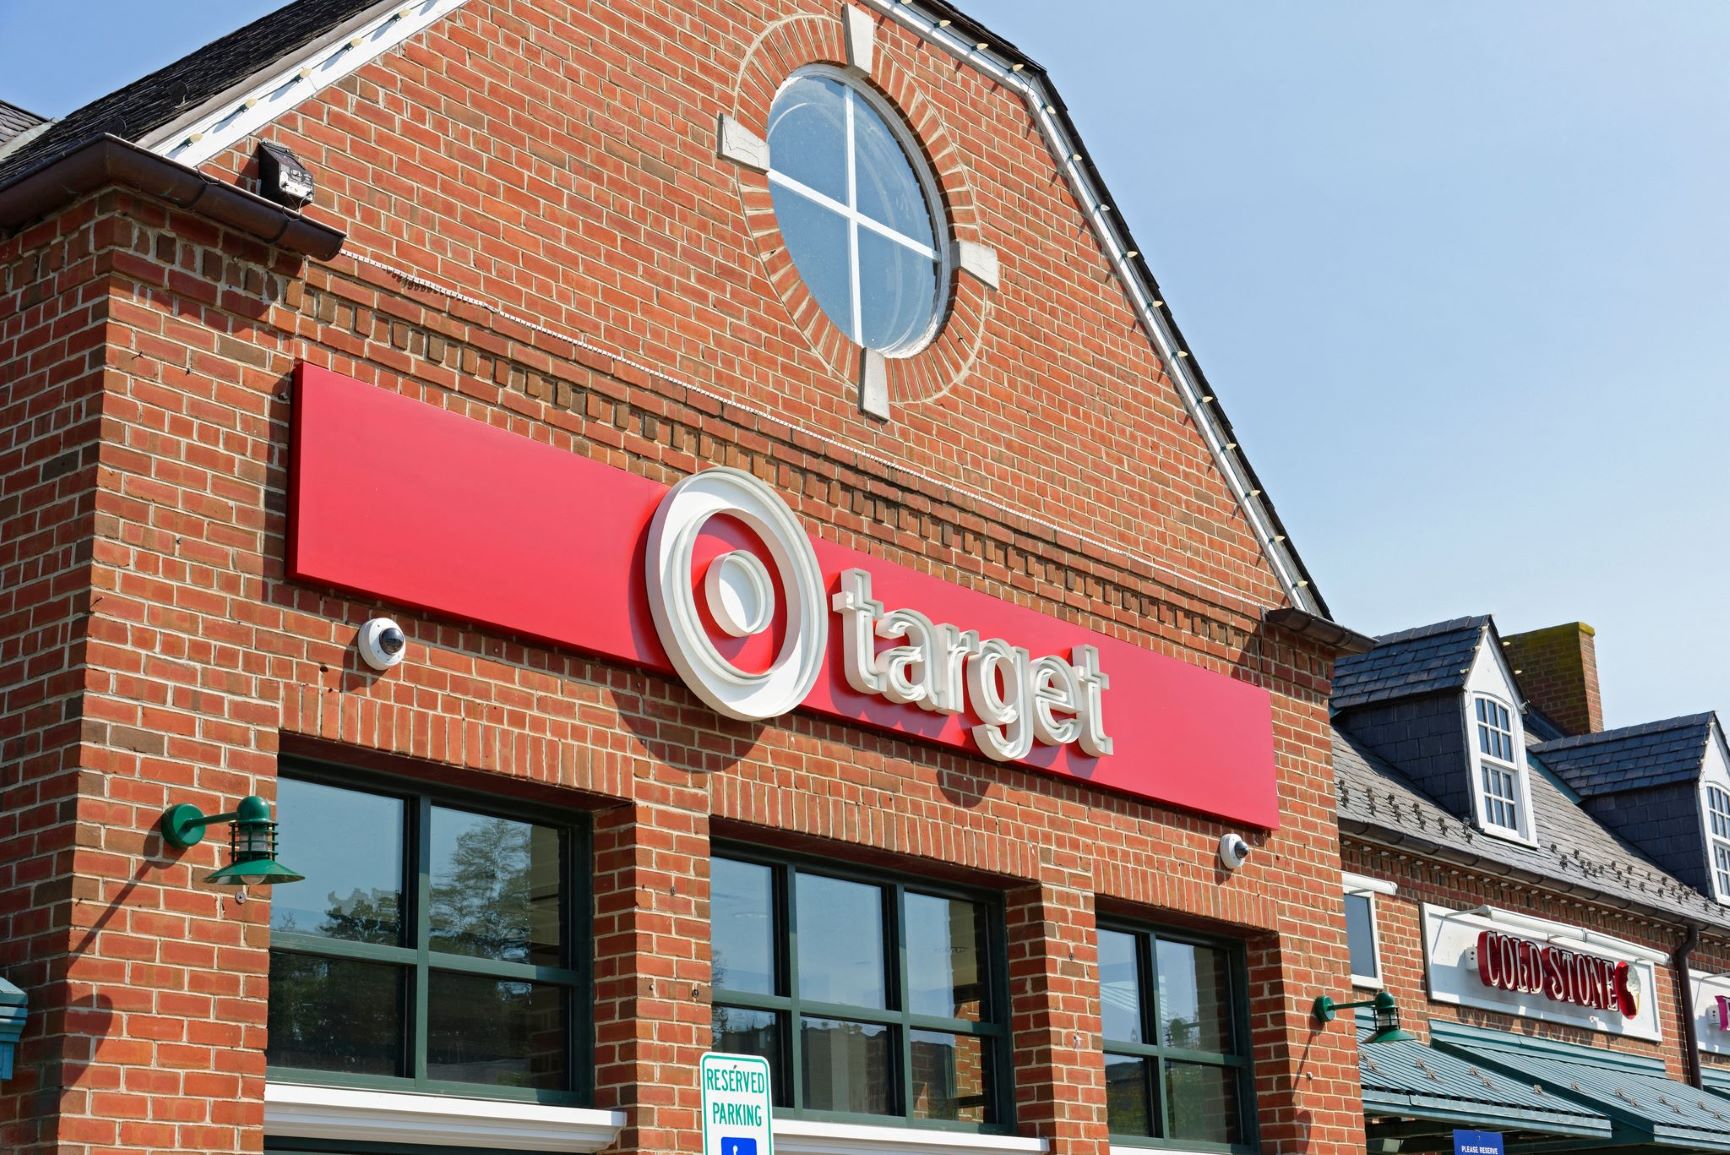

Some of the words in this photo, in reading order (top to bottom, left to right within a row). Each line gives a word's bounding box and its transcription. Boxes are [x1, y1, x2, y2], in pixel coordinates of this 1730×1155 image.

[832, 568, 1114, 760] target
[1478, 931, 1544, 994] COLD
[1541, 946, 1619, 1011] STONE
[706, 1068, 765, 1094] RESERVED
[712, 1101, 762, 1127] PARKING
[1461, 1145, 1479, 1153] PLEASE
[1479, 1146, 1498, 1155] RESERVE
